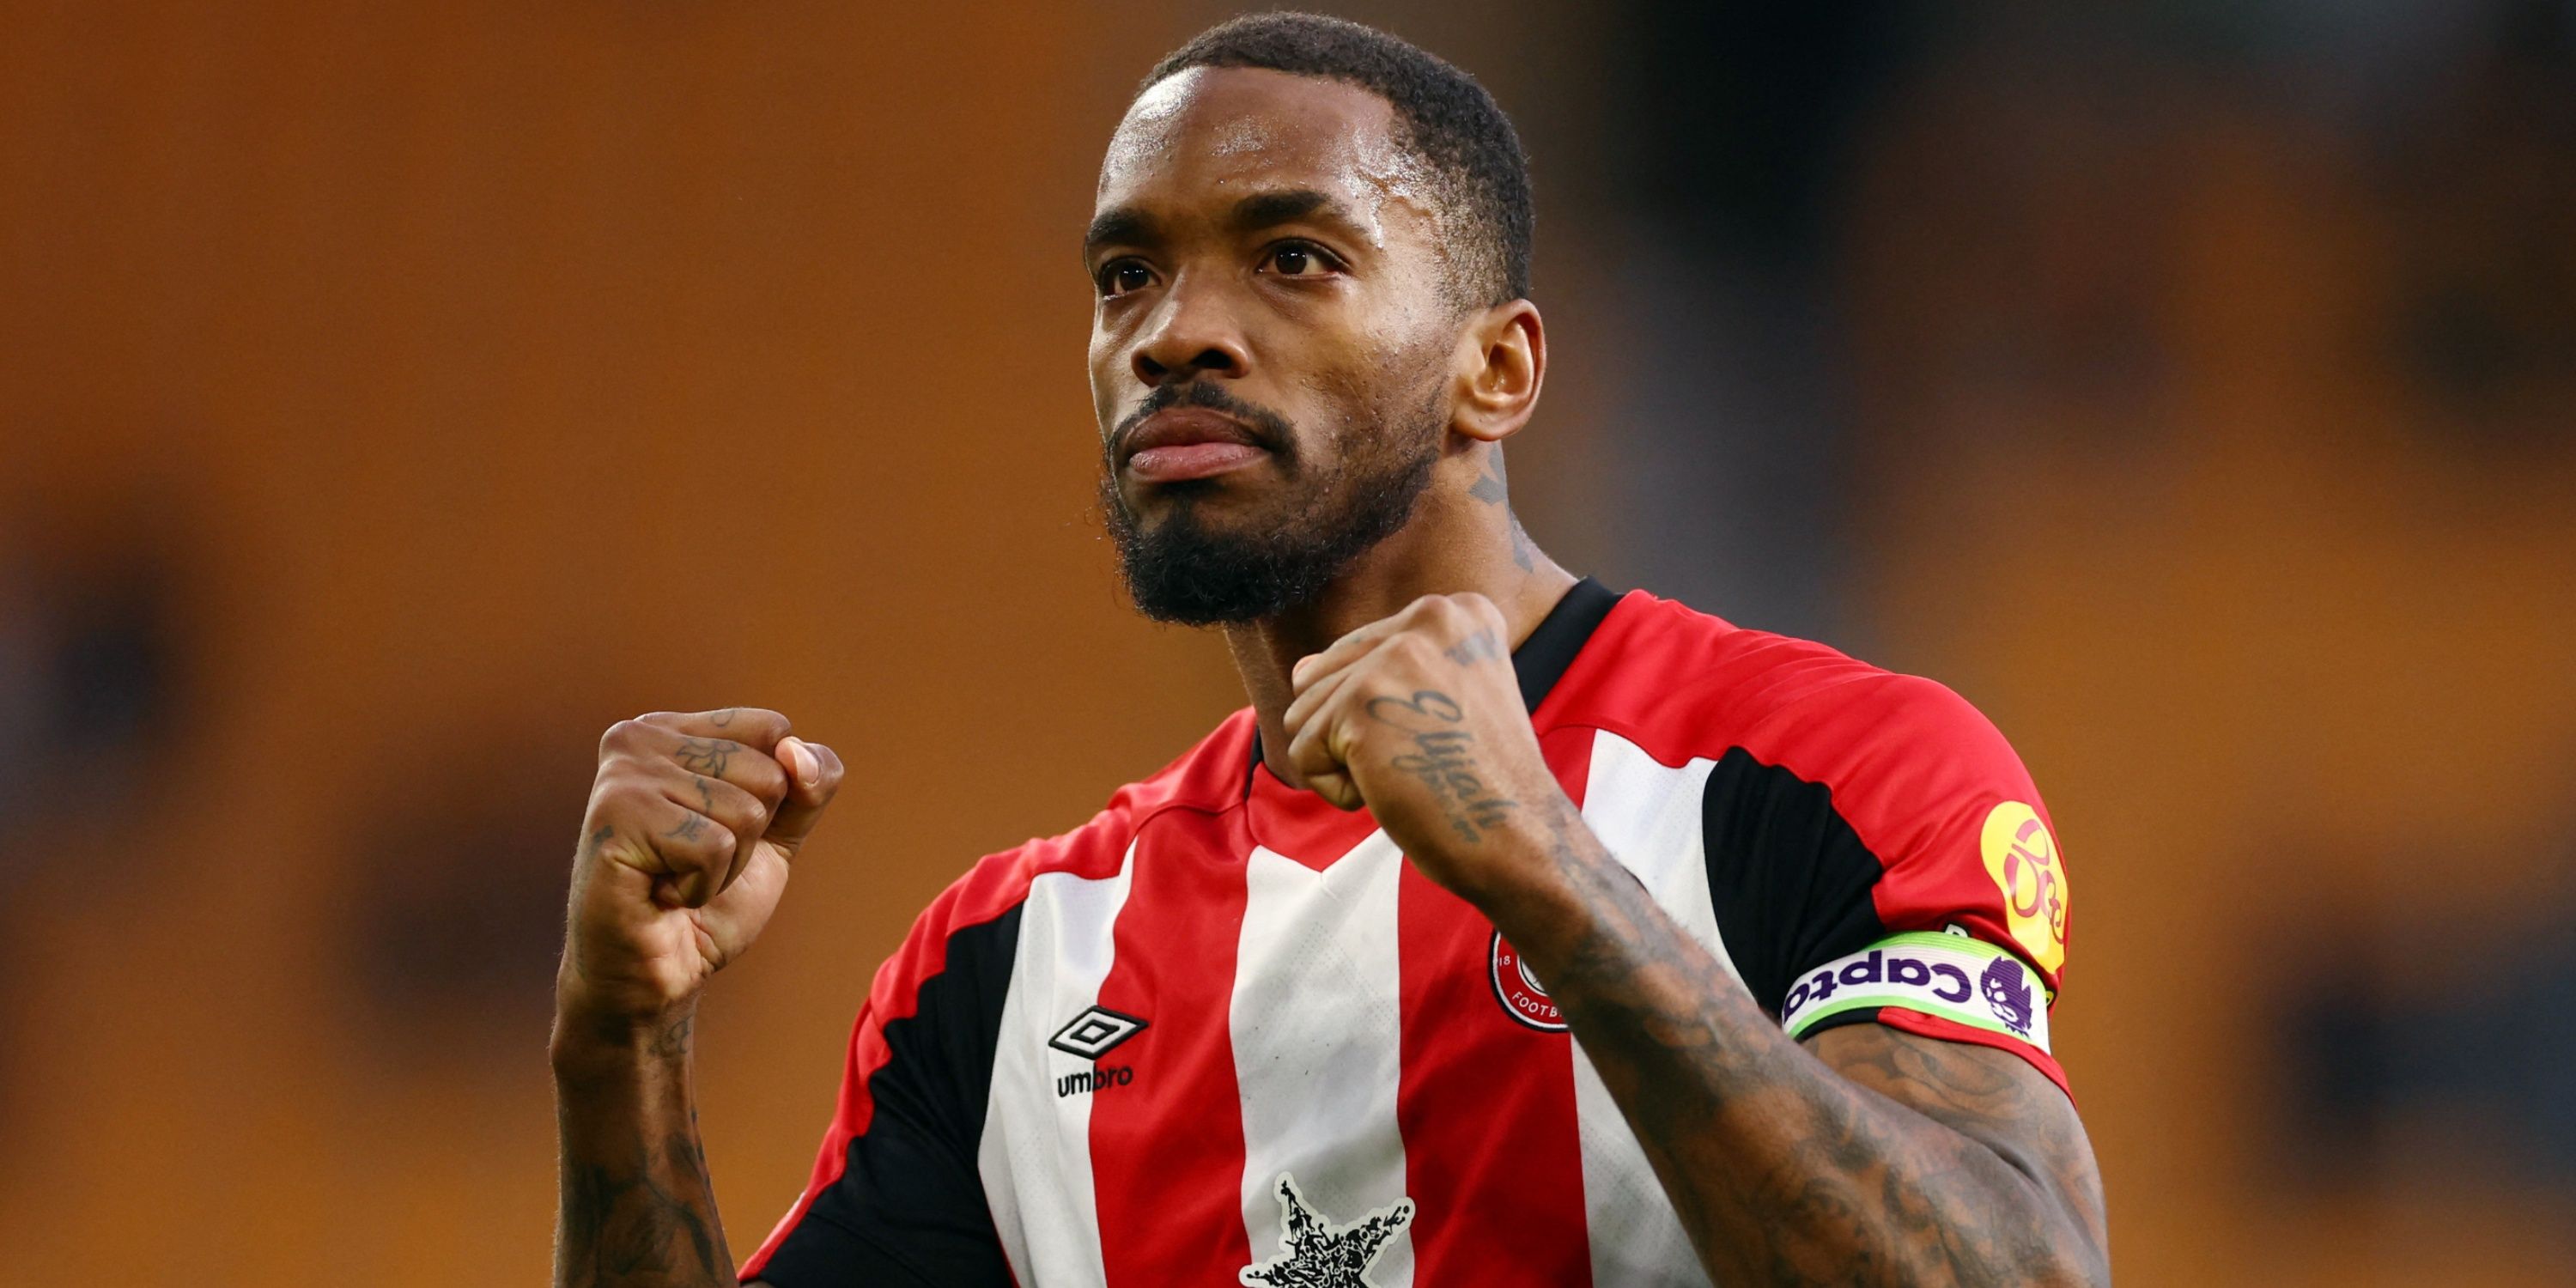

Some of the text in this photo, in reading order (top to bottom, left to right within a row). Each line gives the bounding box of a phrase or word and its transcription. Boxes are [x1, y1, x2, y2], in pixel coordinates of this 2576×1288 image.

[1499, 955, 1511, 967] 18
[1511, 991, 1563, 1018] FOOTB
[1057, 1061, 1133, 1098] umbro
